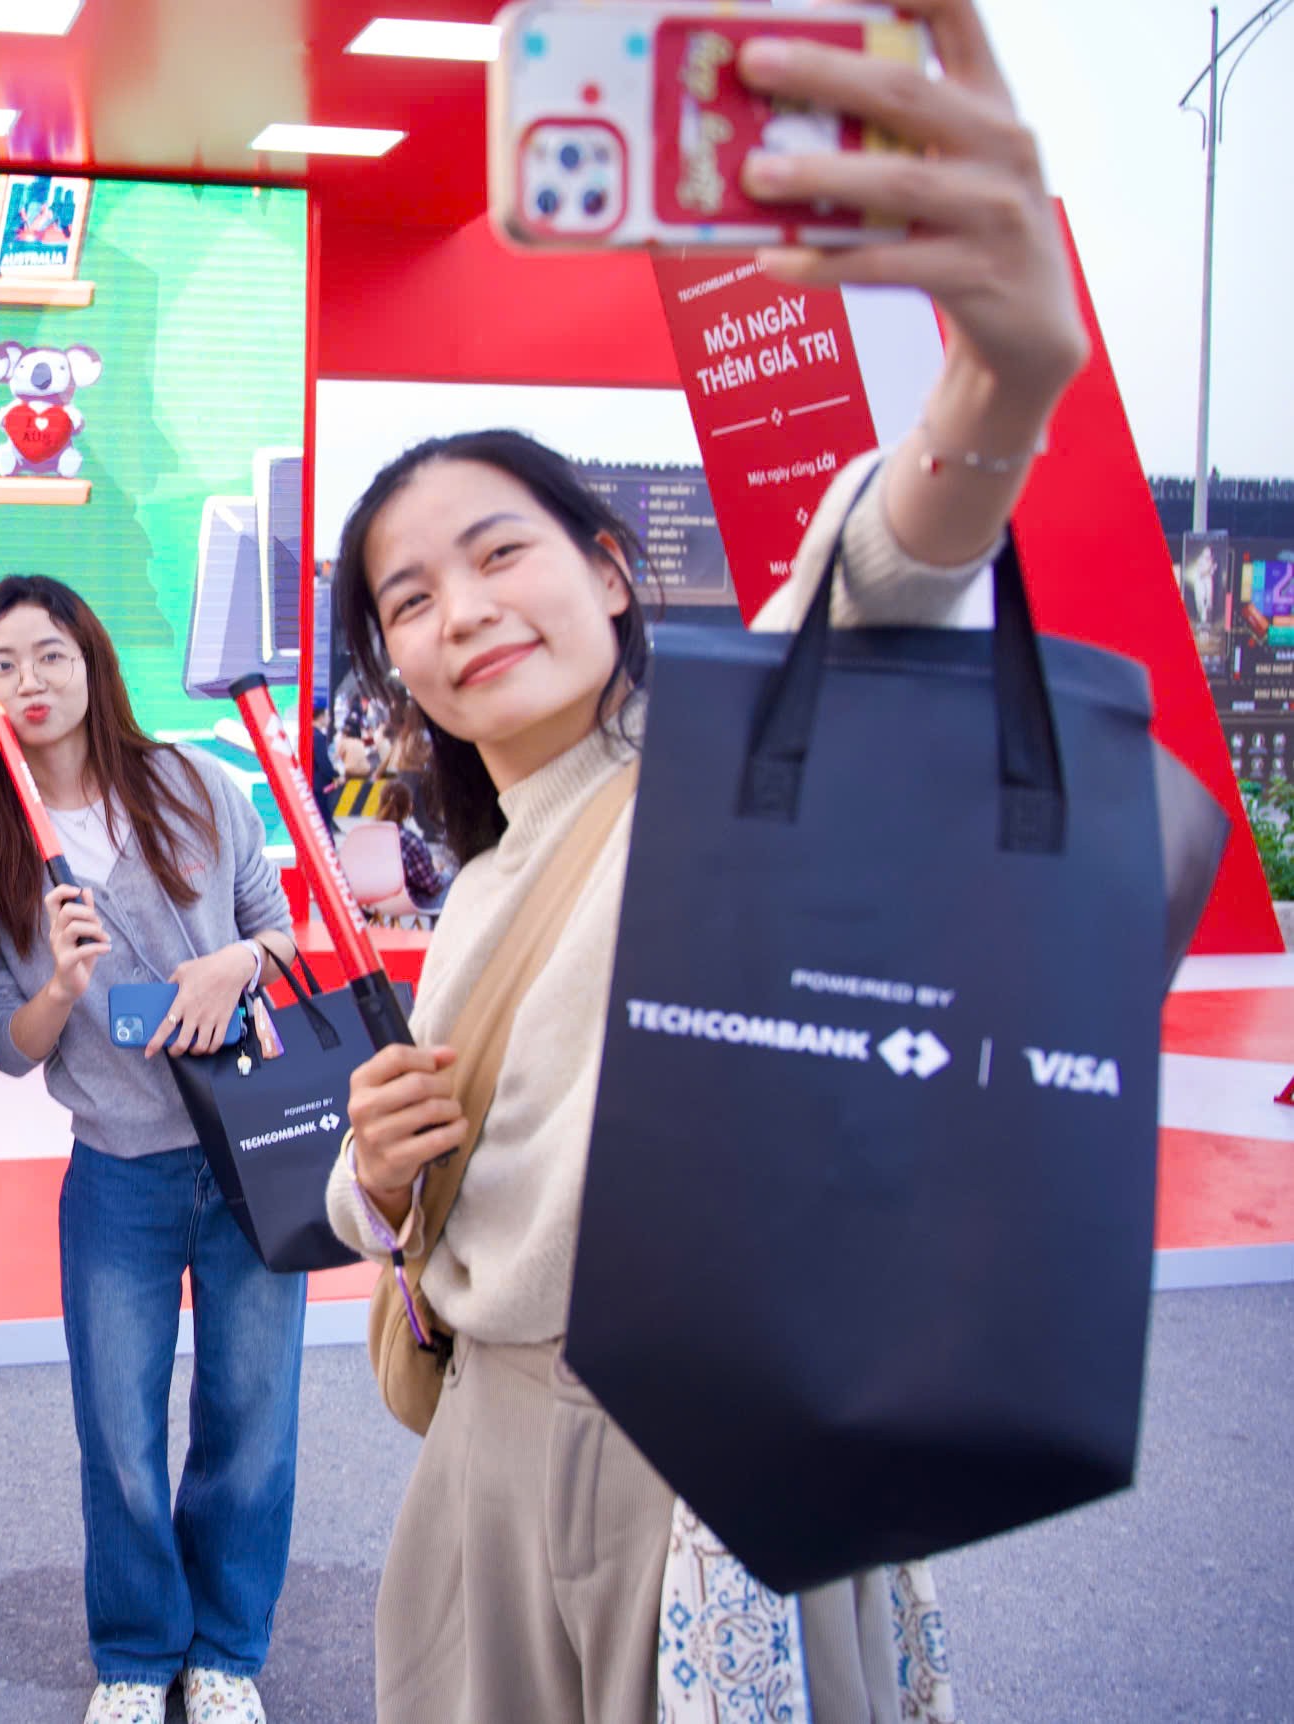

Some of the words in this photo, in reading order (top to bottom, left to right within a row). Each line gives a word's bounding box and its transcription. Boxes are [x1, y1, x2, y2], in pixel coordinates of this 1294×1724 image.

[0, 250, 66, 266] AUSTRALIA
[677, 271, 734, 303] TECHCOMBANK
[703, 311, 746, 356] MỖI
[746, 294, 807, 341] NGÀY
[696, 355, 756, 396] THÊM
[757, 335, 799, 378] GIÁ
[798, 327, 840, 364] TRỊ
[288, 765, 366, 934] TECHCOMBANK
[791, 968, 914, 1004] POWERED
[915, 984, 955, 1008] BY
[627, 999, 871, 1062] TECHCOMBANK
[1022, 1045, 1121, 1097] VISA
[284, 1099, 321, 1117] POWERED
[322, 1096, 334, 1107] BY
[239, 1120, 318, 1152] TECHCOMBANK
